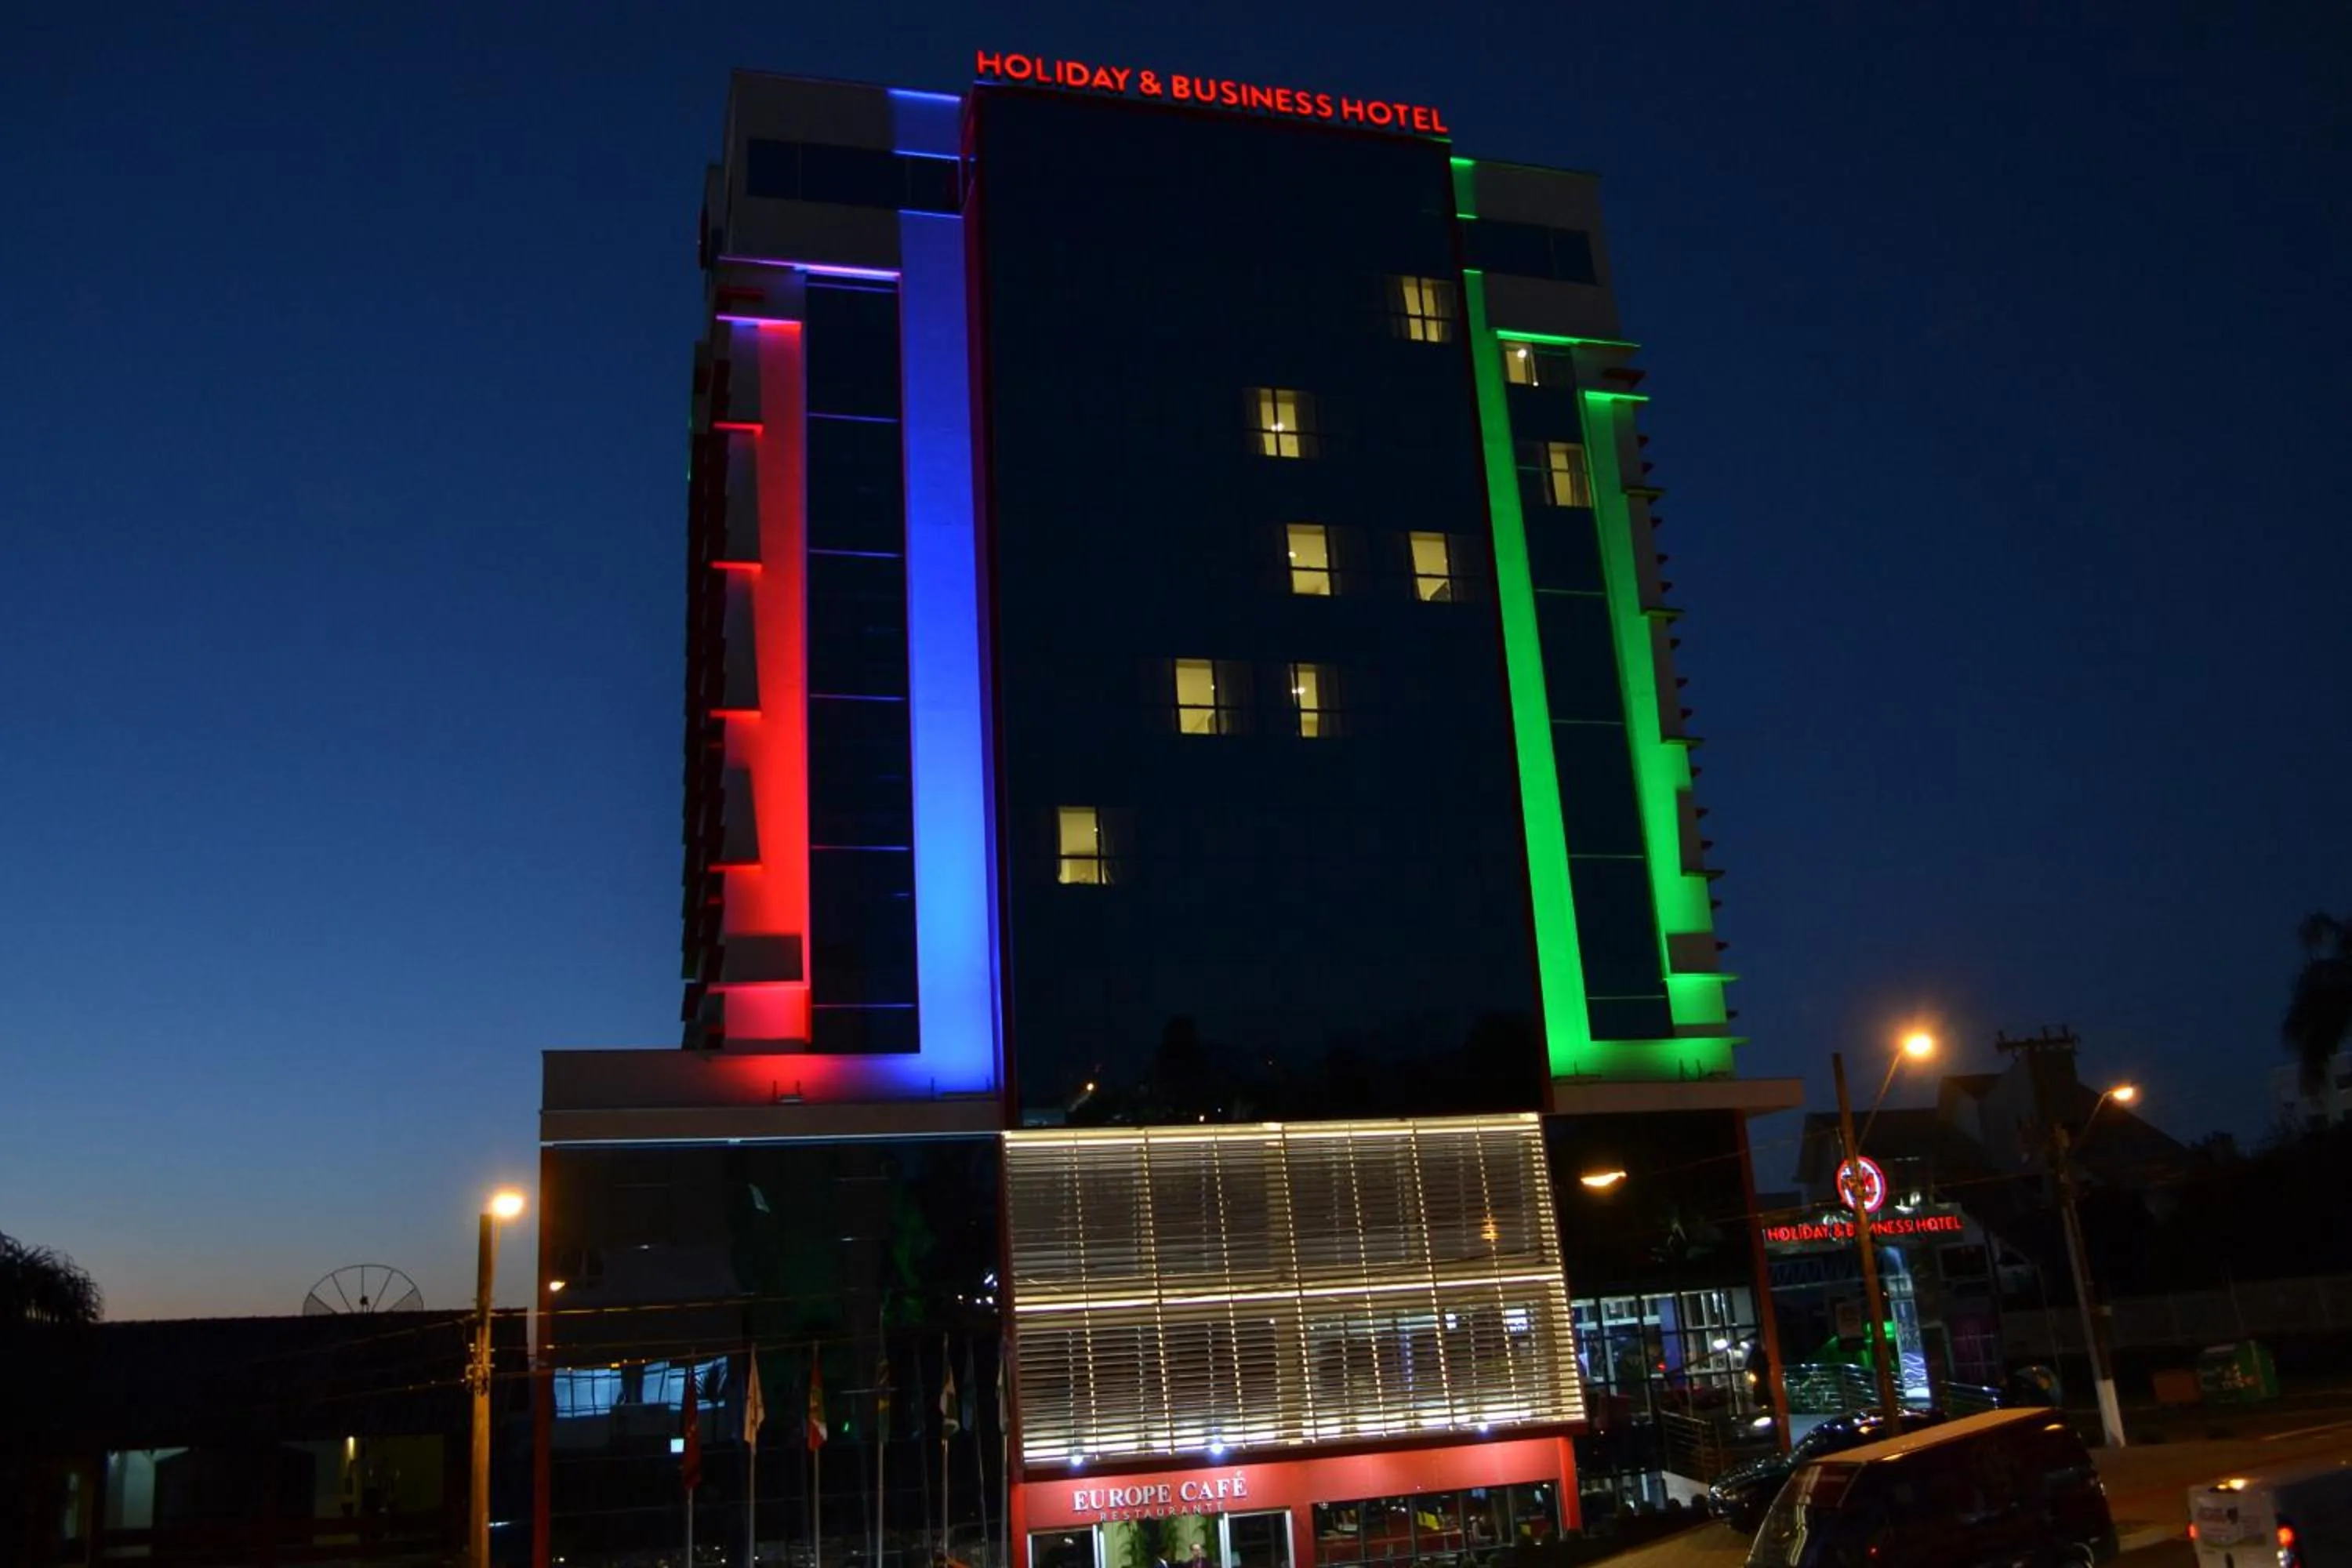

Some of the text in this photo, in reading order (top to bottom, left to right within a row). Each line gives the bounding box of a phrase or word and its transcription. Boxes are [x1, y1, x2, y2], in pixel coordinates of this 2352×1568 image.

[976, 49, 1449, 133] HOLIDAY & BUSINESS HOTEL
[1767, 1222, 1829, 1242] HOLIDAY
[1915, 1215, 1962, 1232] HOTEL
[1073, 1470, 1248, 1512] EUROPE CAFÉ
